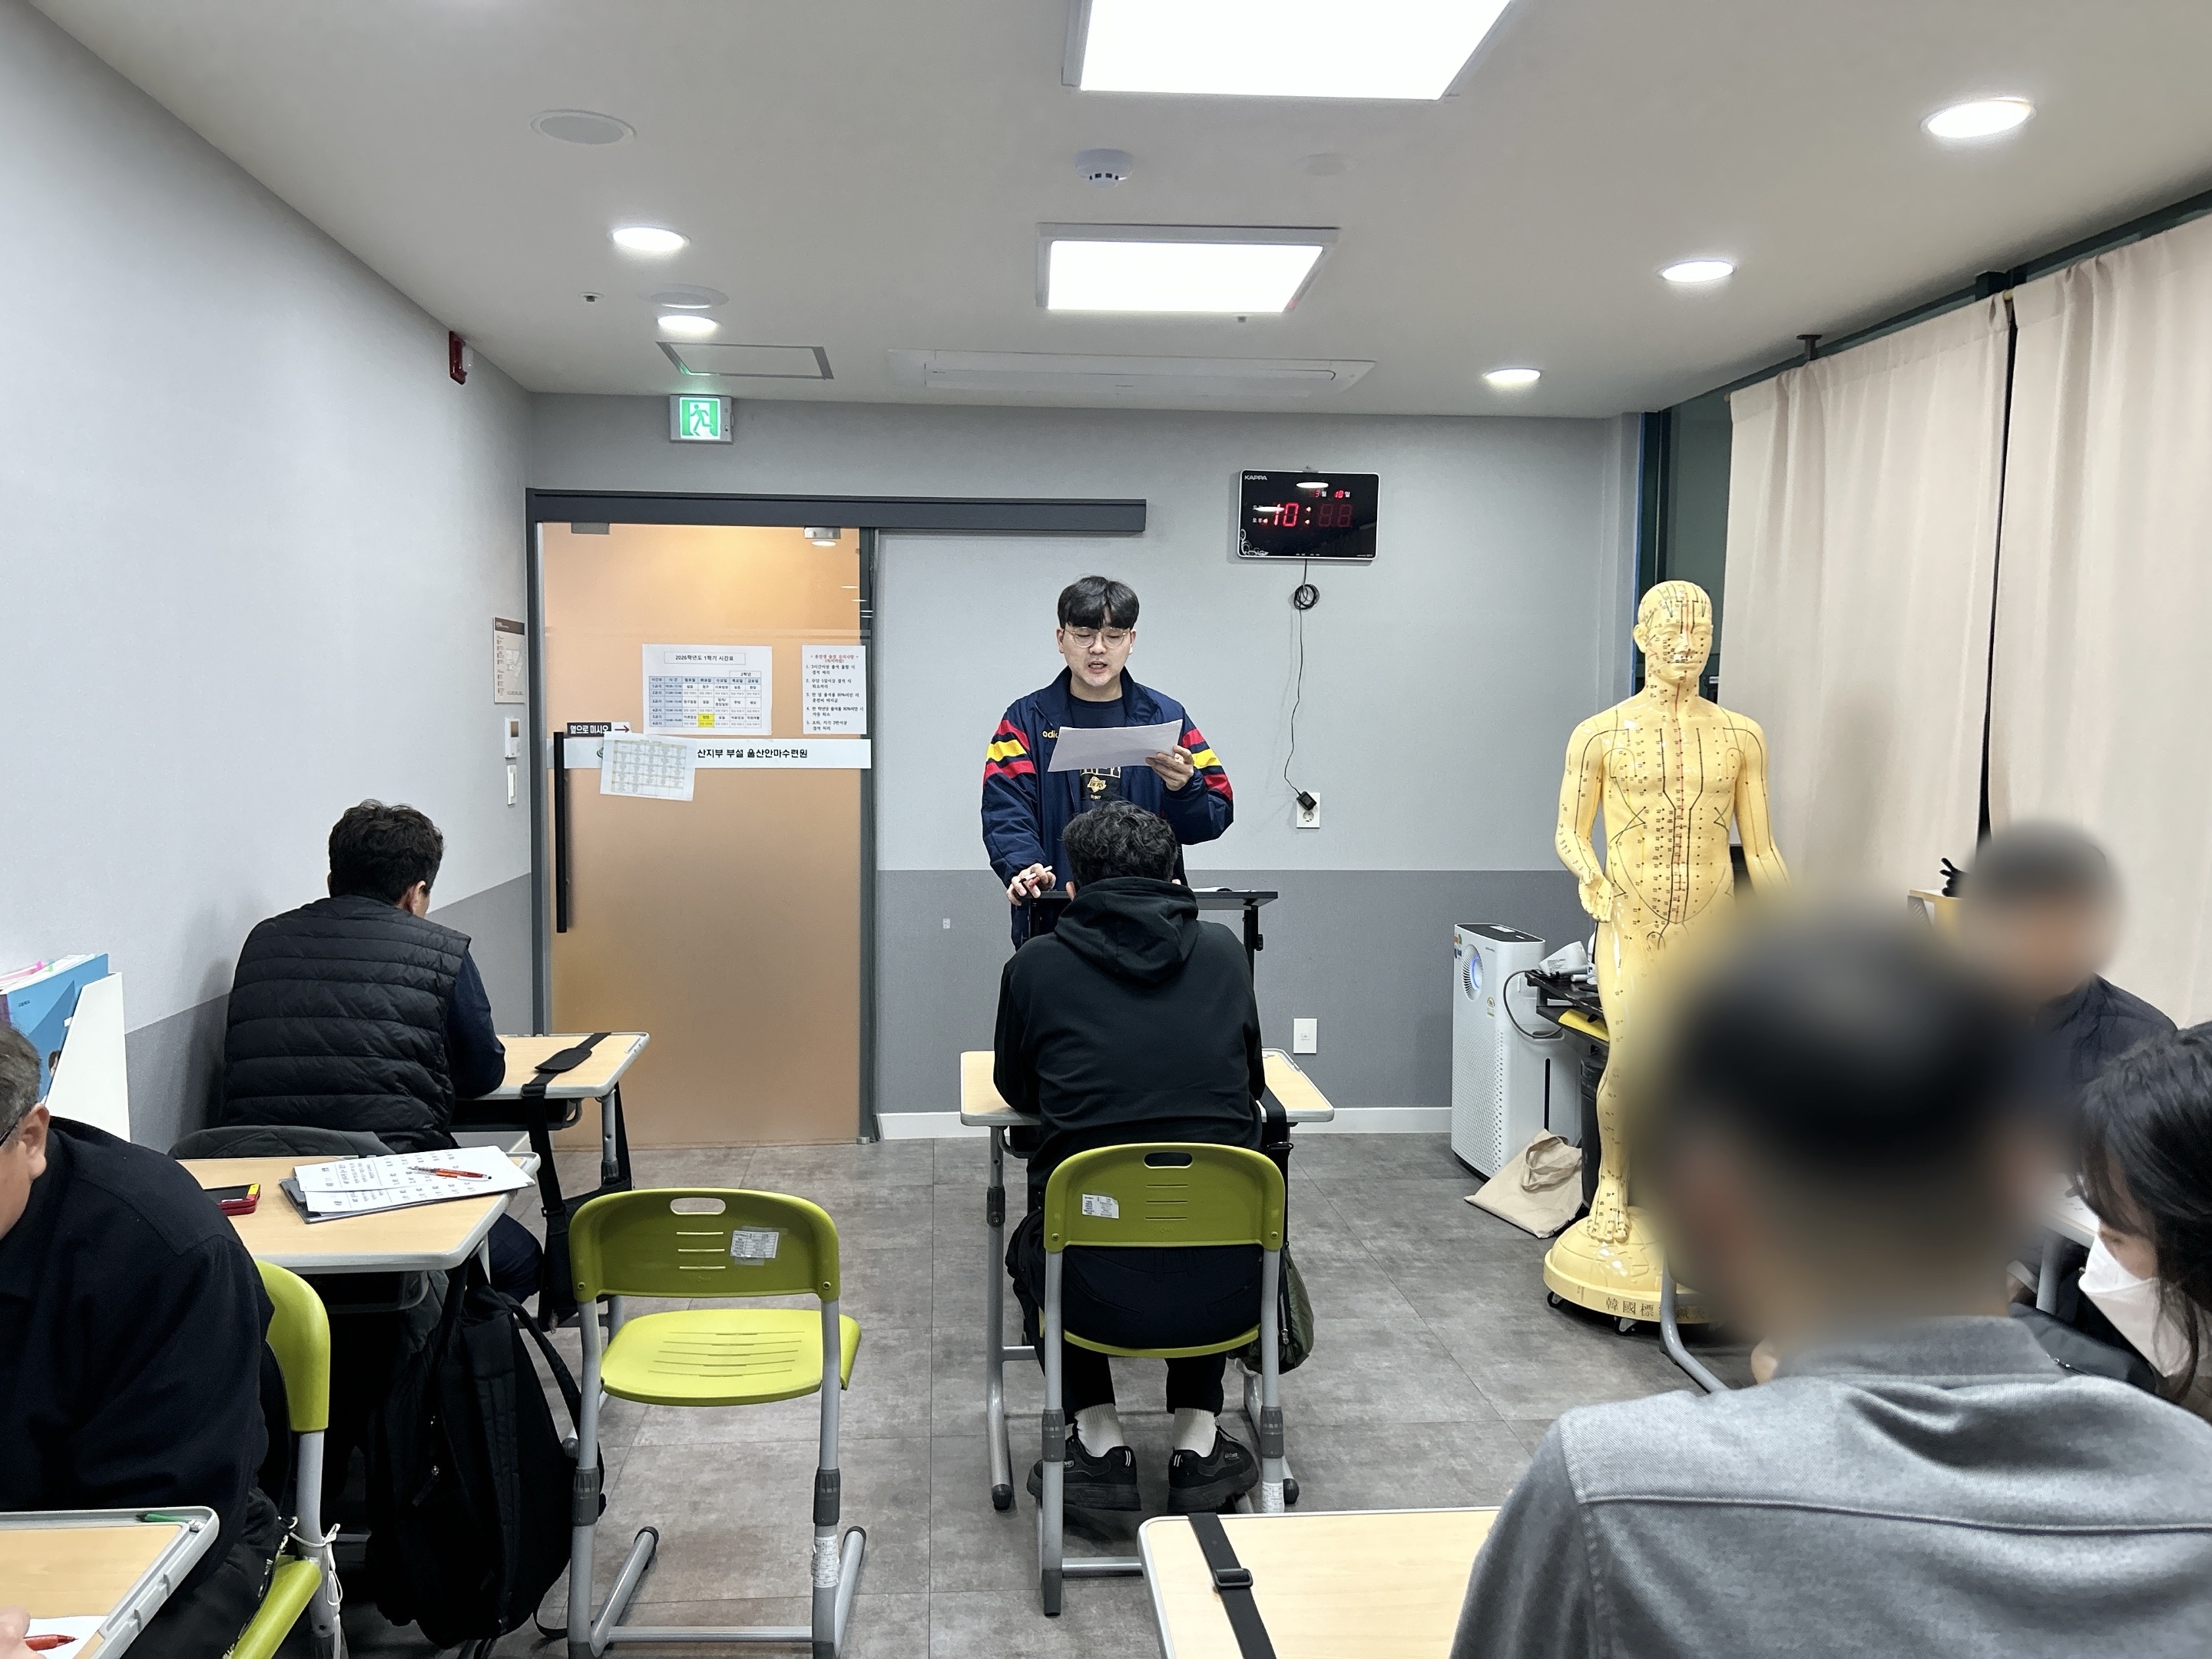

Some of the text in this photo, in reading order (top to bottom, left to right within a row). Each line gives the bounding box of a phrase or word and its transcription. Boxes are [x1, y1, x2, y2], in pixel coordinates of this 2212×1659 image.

[570, 725, 609, 734] 옆으로 미시오
[697, 748, 808, 758] 산지부 부설 울산안마수련원
